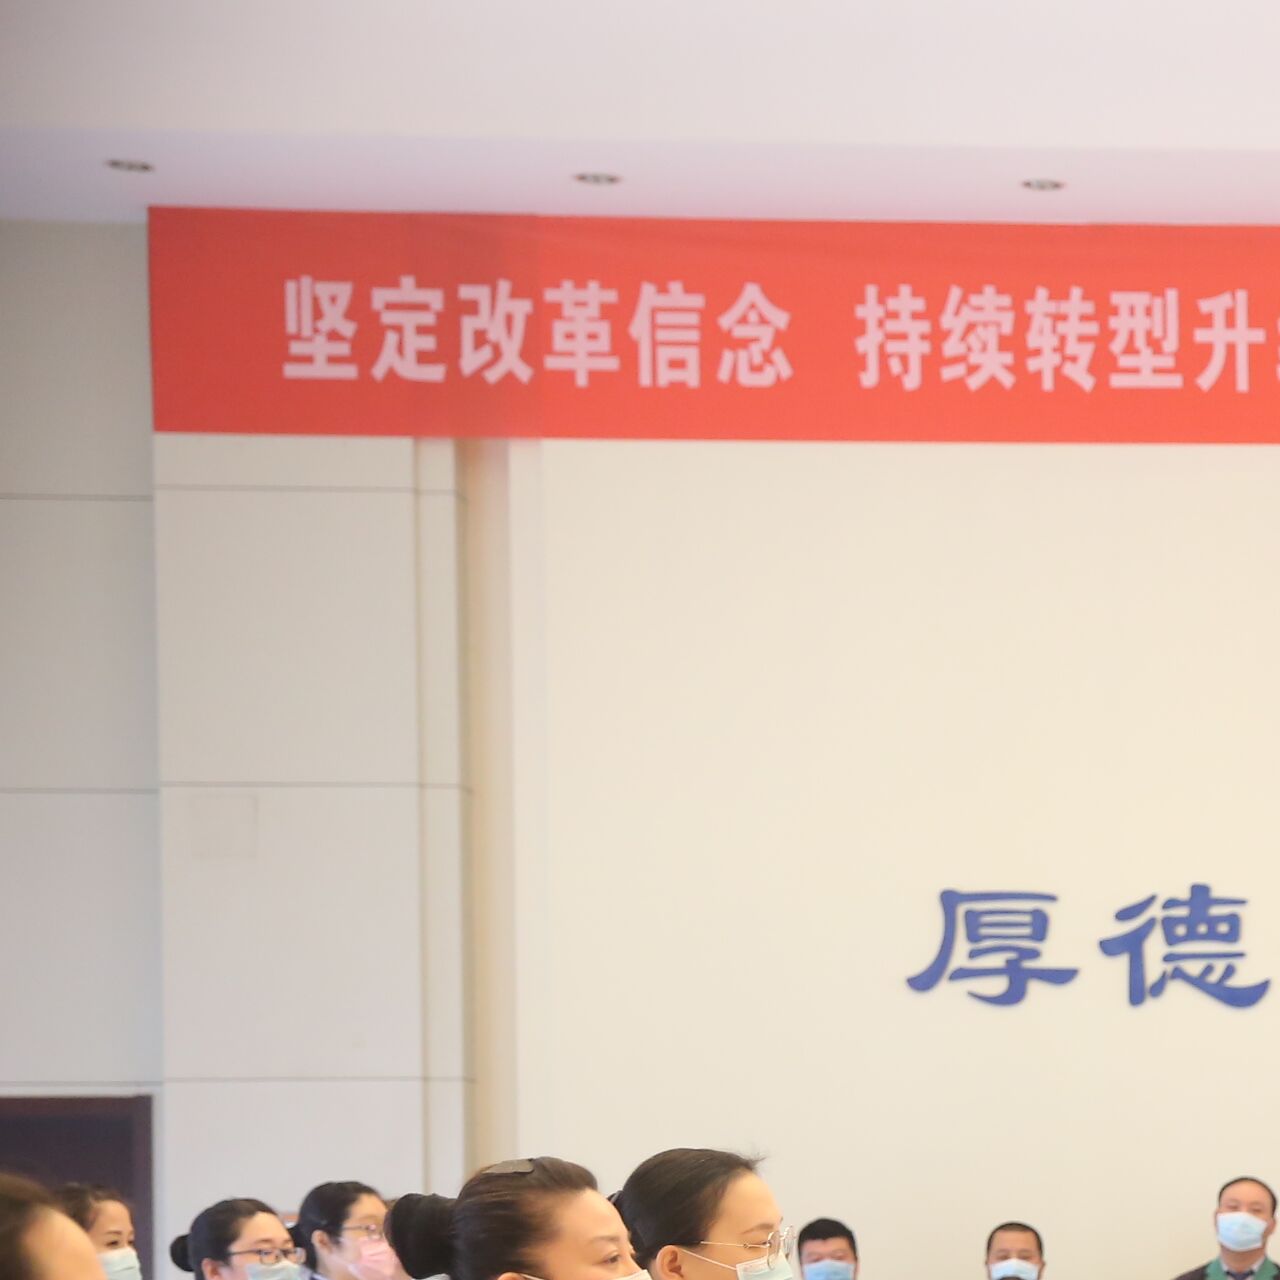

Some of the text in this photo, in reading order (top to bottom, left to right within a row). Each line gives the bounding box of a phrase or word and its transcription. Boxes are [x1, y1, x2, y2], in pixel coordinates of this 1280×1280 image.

[282, 275, 794, 388] 坚定改革信念
